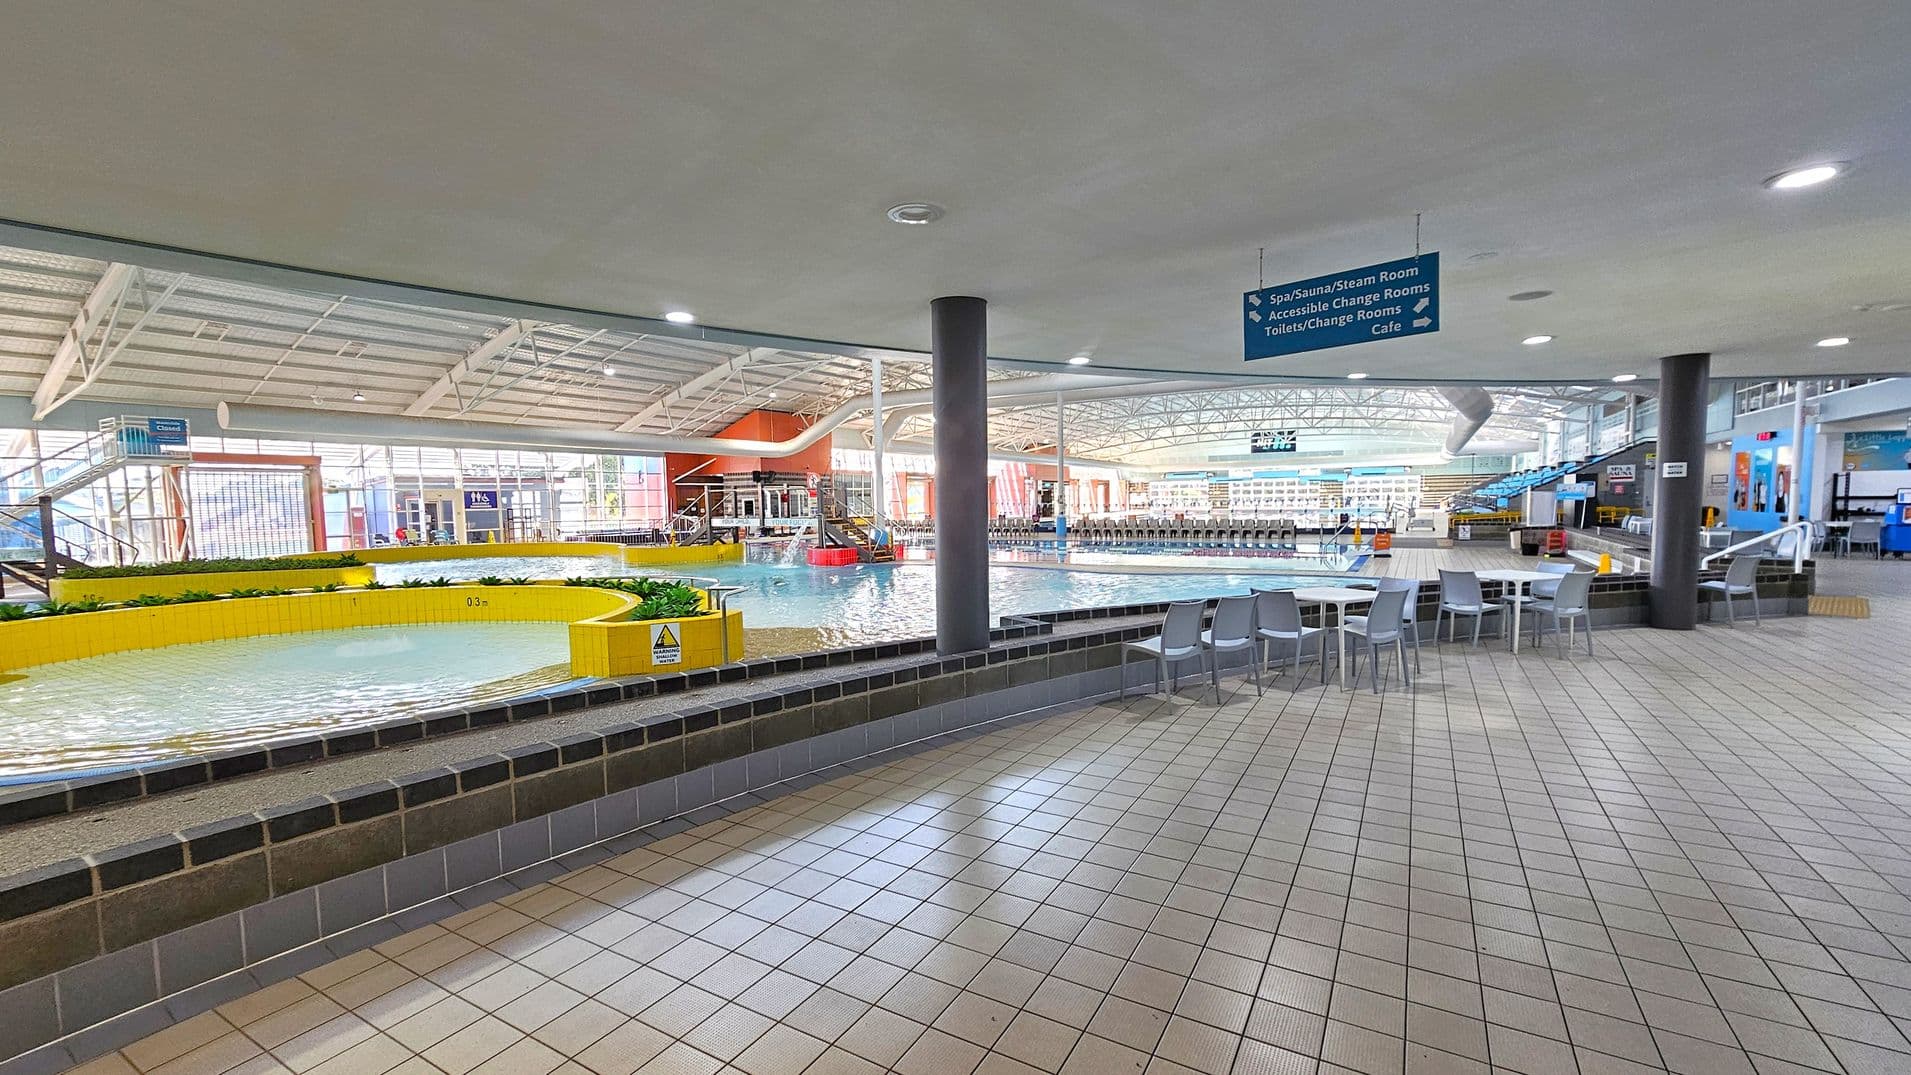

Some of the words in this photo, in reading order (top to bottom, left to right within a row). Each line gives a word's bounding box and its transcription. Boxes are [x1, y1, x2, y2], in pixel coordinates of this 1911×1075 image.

[1268, 301, 1329, 321] Accessible
[1332, 292, 1381, 310] Change
[1383, 281, 1430, 300] Rooms
[1270, 274, 1376, 306] Spa/Sauna/Steam
[1379, 265, 1419, 282] Room
[1264, 311, 1354, 337] Toilets/Change
[1356, 304, 1402, 321] Rooms
[1371, 321, 1402, 336] Cafe
